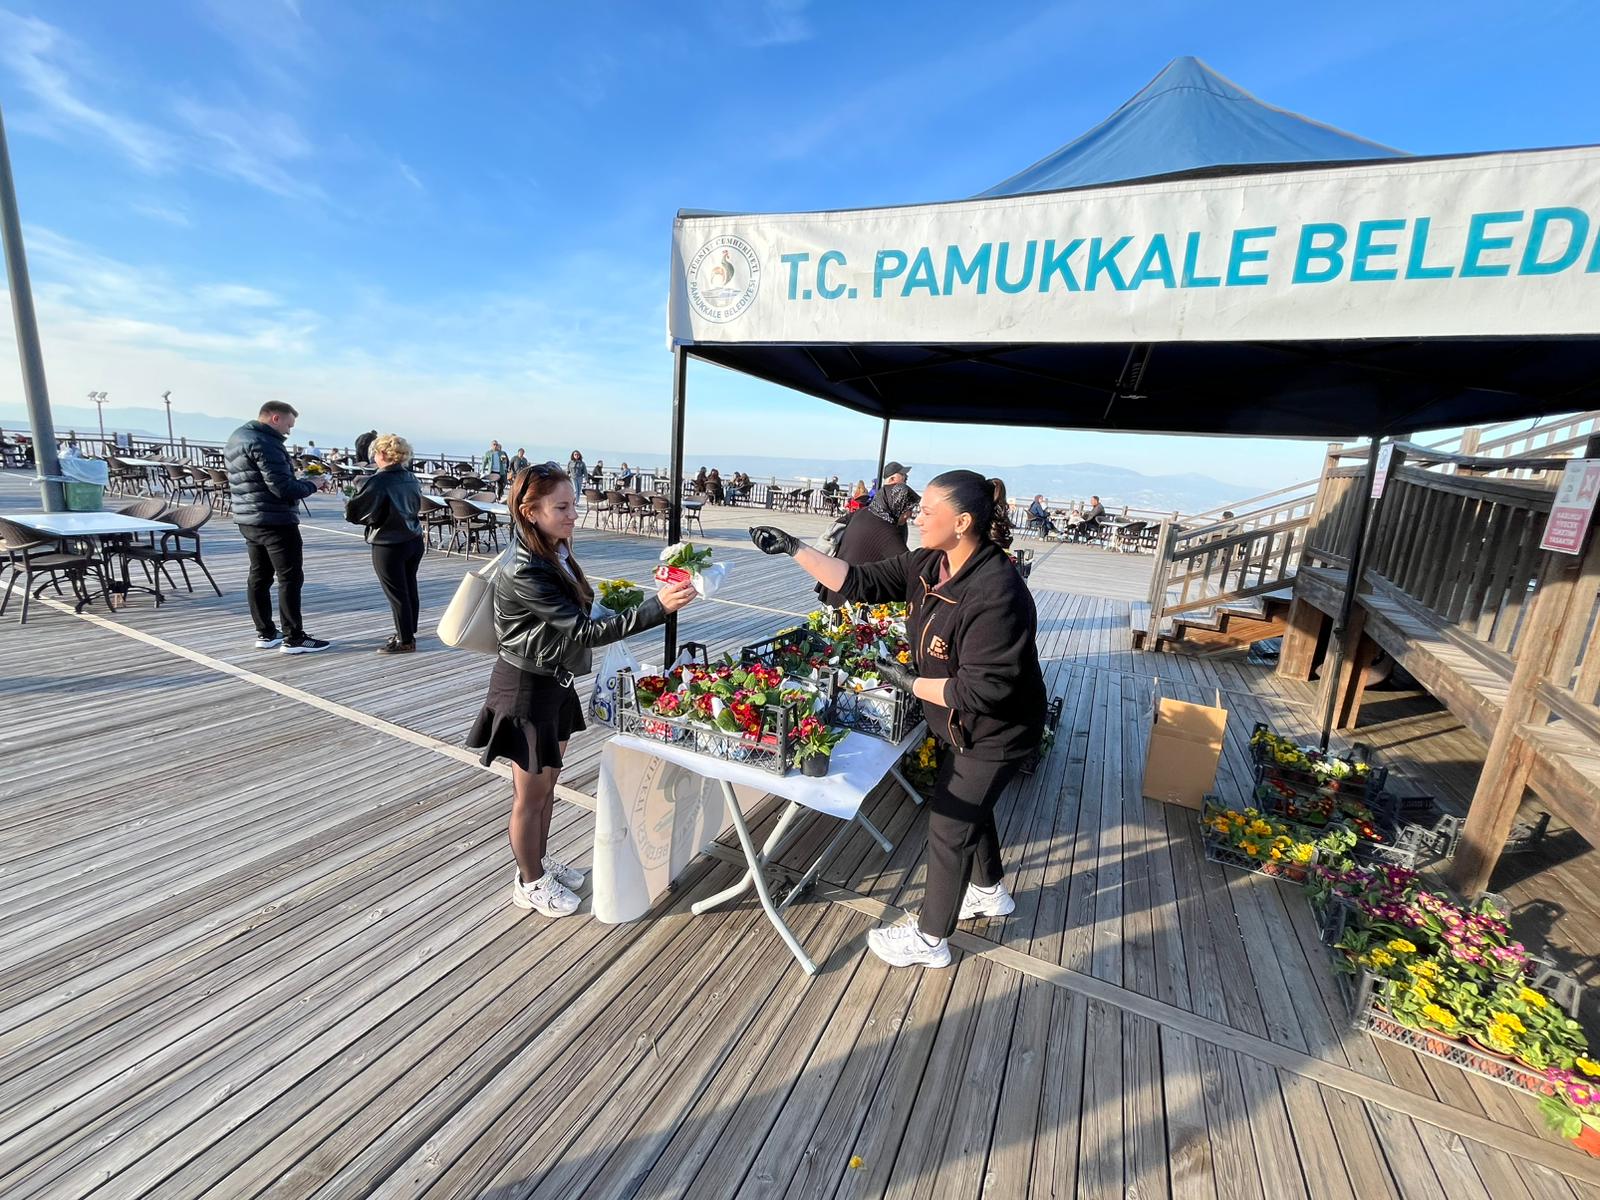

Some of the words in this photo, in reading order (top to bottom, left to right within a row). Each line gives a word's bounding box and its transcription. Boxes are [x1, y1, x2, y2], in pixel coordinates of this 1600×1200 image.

[780, 249, 858, 300] T.C.
[872, 225, 1277, 298] PAMUKKALE
[690, 281, 722, 318] PAMUKKALE
